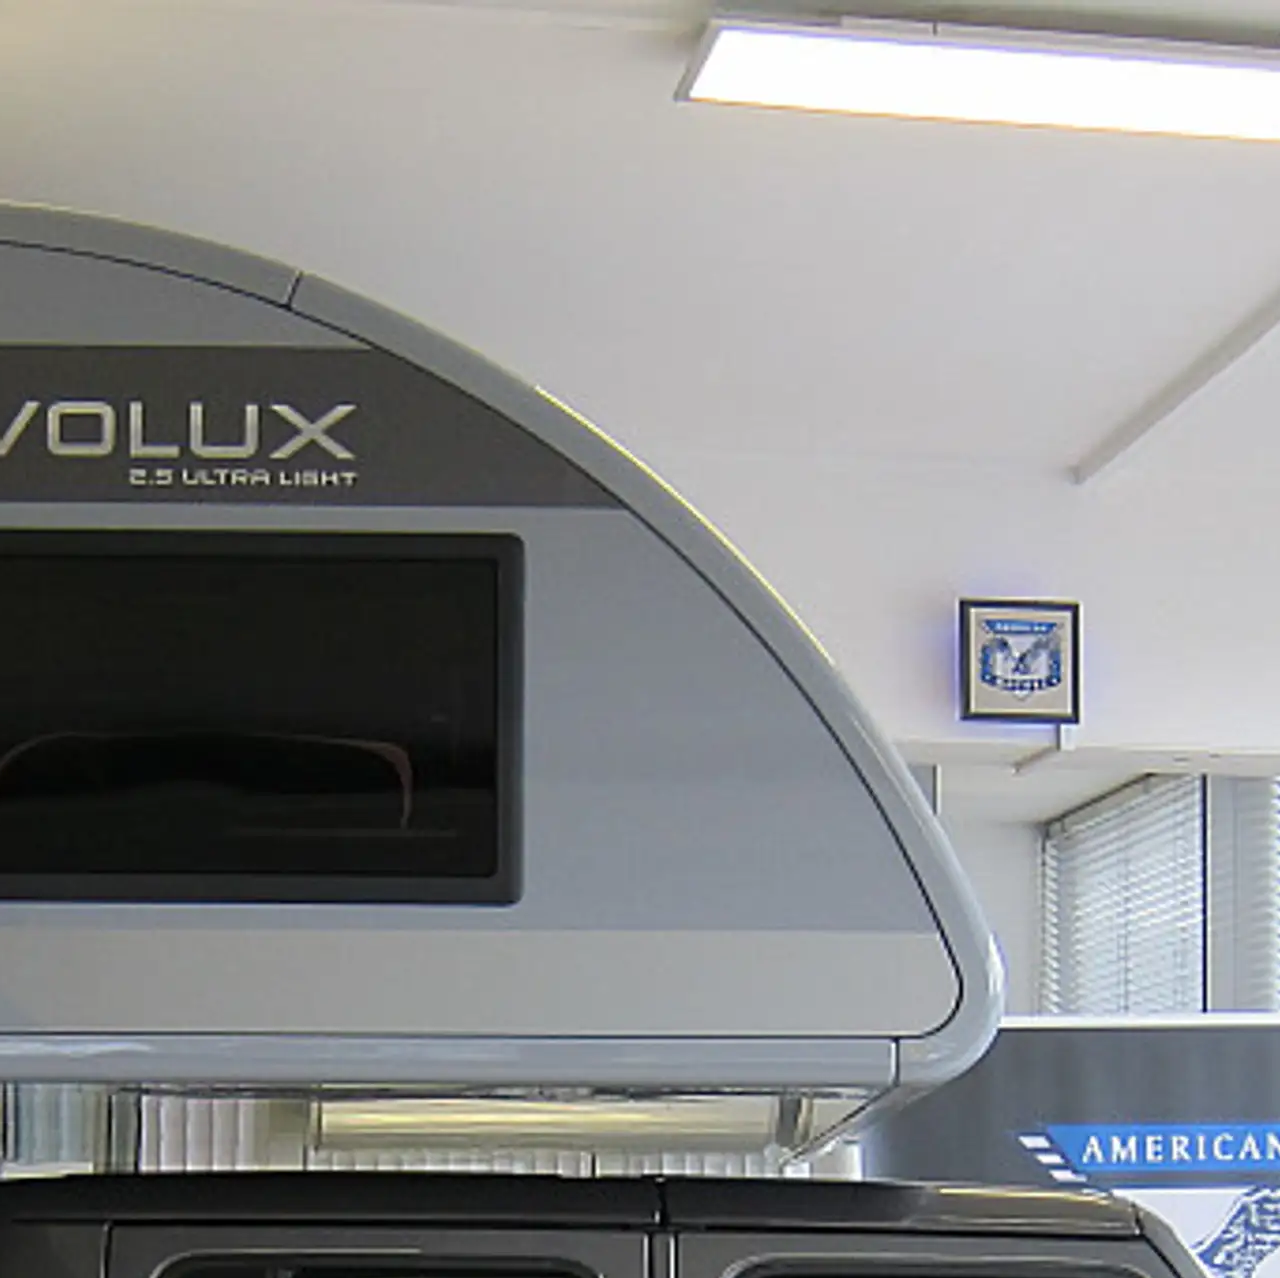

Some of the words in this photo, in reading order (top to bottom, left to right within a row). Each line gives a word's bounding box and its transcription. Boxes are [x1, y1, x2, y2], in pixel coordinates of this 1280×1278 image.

[129, 468, 173, 485] 2.5
[182, 468, 270, 486] ULTRA
[278, 470, 359, 487] LIGHT
